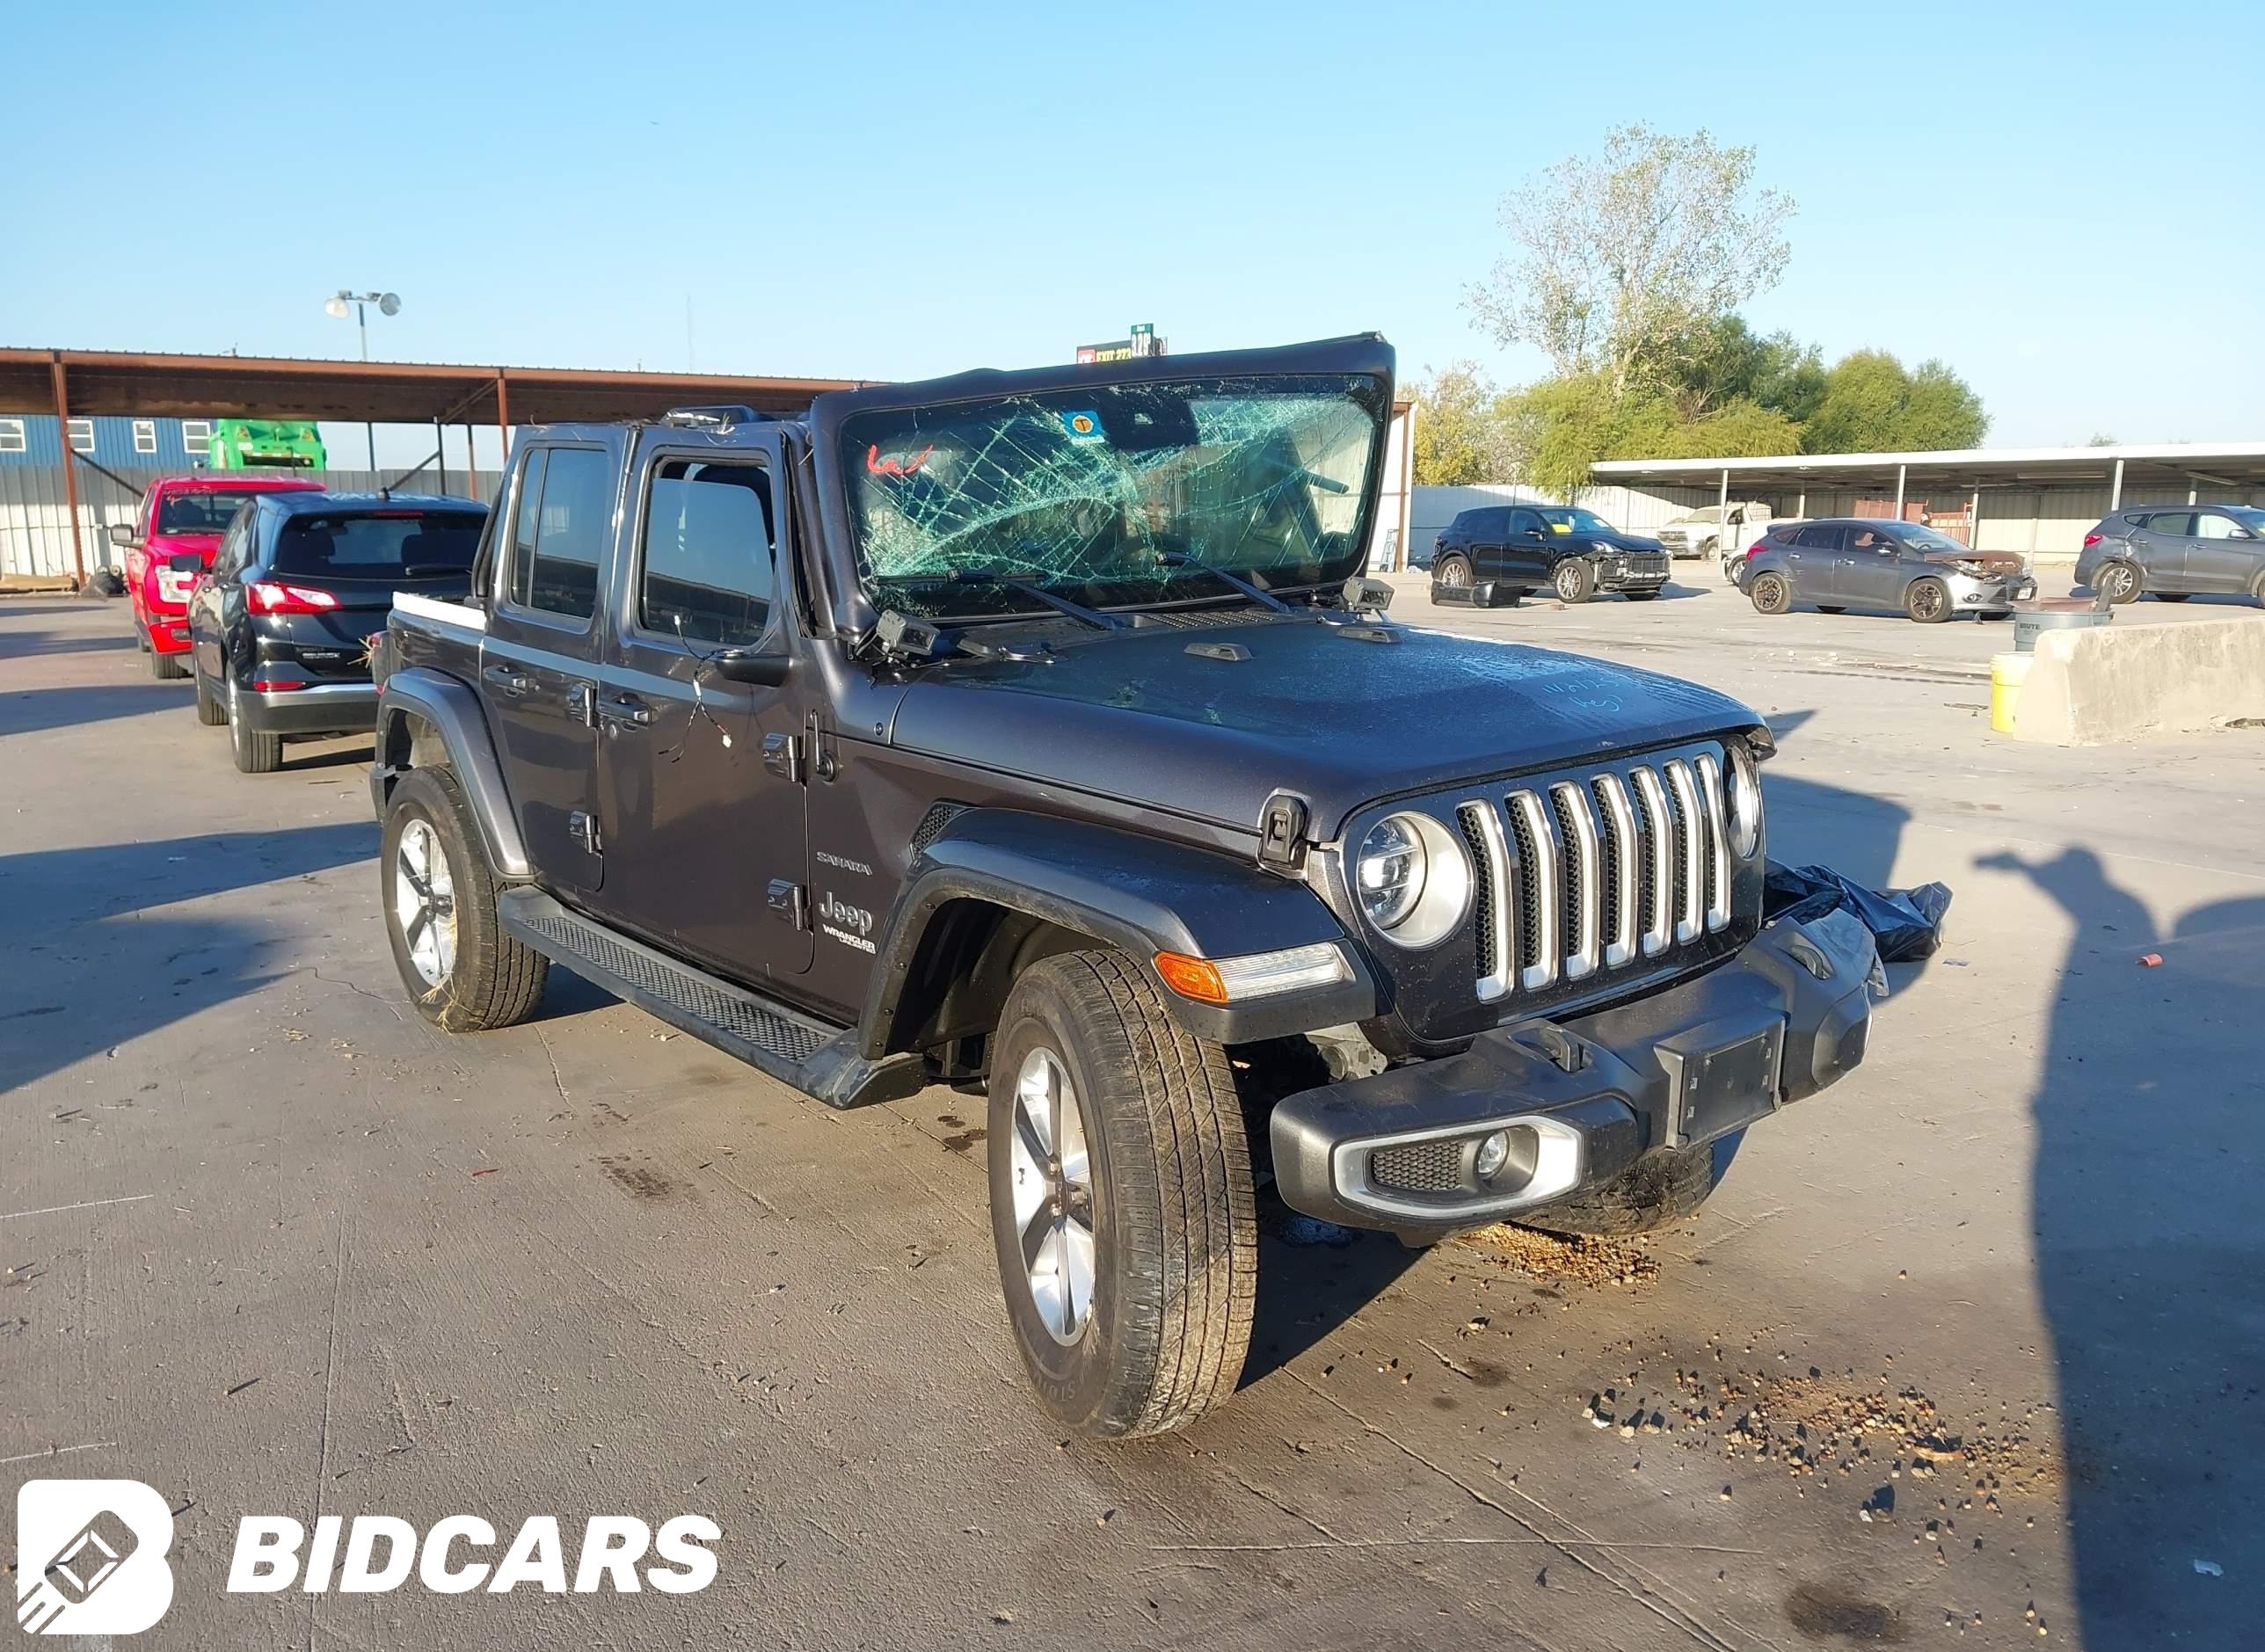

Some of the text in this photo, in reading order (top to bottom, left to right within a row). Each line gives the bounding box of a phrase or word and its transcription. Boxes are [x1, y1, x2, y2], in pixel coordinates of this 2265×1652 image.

[1096, 350, 1115, 362] EXIT
[817, 851, 873, 876] SAHARA
[819, 891, 873, 936] Jeep
[823, 923, 876, 950] WRANGLER
